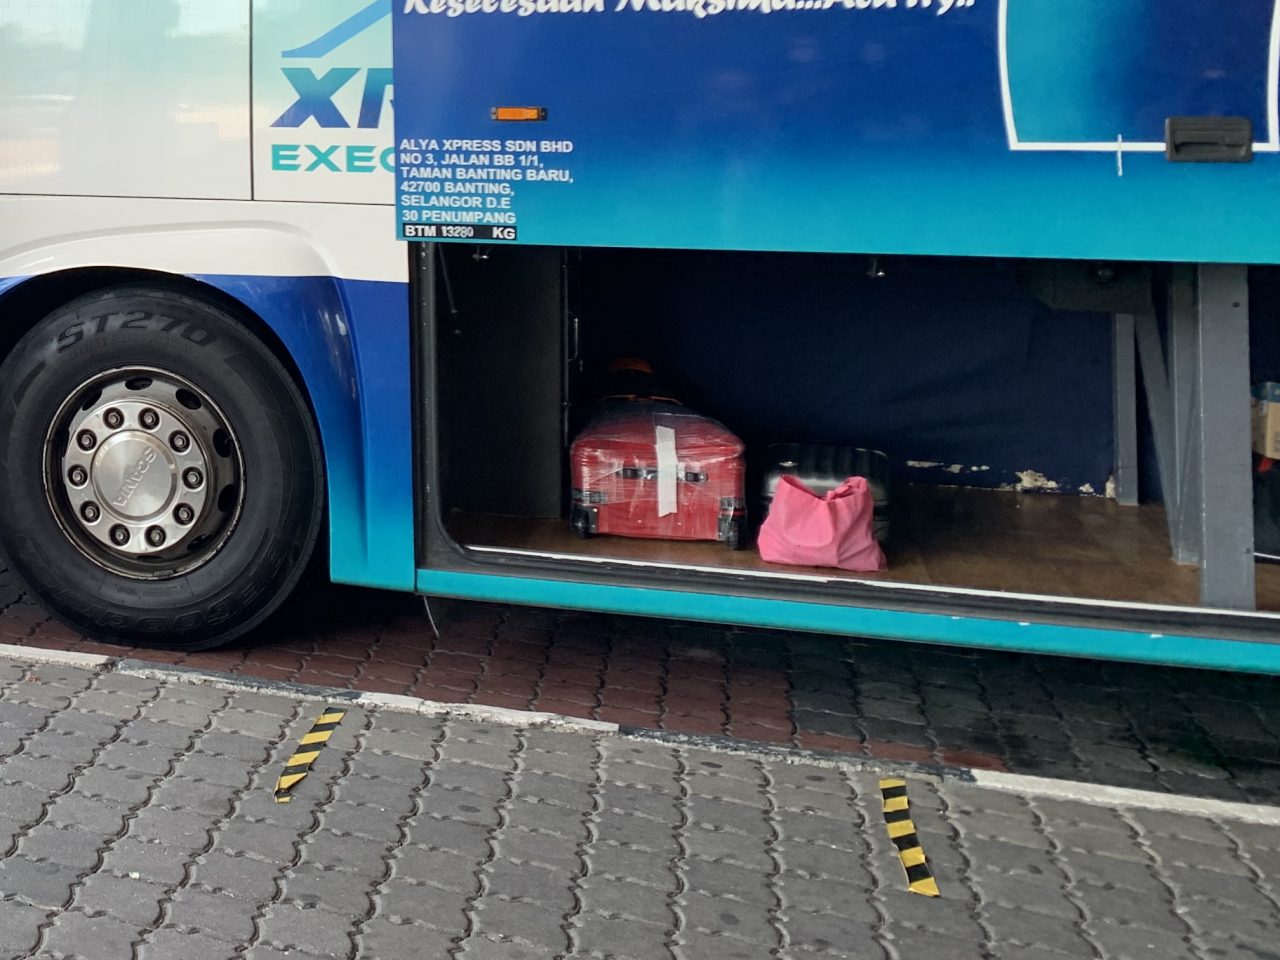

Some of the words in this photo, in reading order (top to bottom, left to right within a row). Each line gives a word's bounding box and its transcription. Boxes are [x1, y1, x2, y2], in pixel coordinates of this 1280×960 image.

[400, 139, 439, 151] ALYA
[442, 139, 502, 152] XPRESS
[504, 140, 537, 152] SDN
[540, 141, 573, 153] BHD
[400, 153, 422, 164] NO
[425, 154, 437, 166] 3,
[441, 154, 490, 165] JALAN
[493, 154, 515, 166] BB
[400, 166, 452, 179] TAMAN
[455, 168, 522, 181] BANTING
[526, 169, 574, 184] BARU,
[400, 181, 440, 193] 42700
[444, 182, 515, 196] BANTING,
[400, 195, 483, 208] SELANGOR
[486, 197, 511, 209] D.E
[402, 210, 418, 221] 30
[422, 210, 516, 223] PENUMPANG
[405, 225, 437, 237] BTM
[492, 226, 516, 239] KG
[56, 310, 217, 353] ST270
